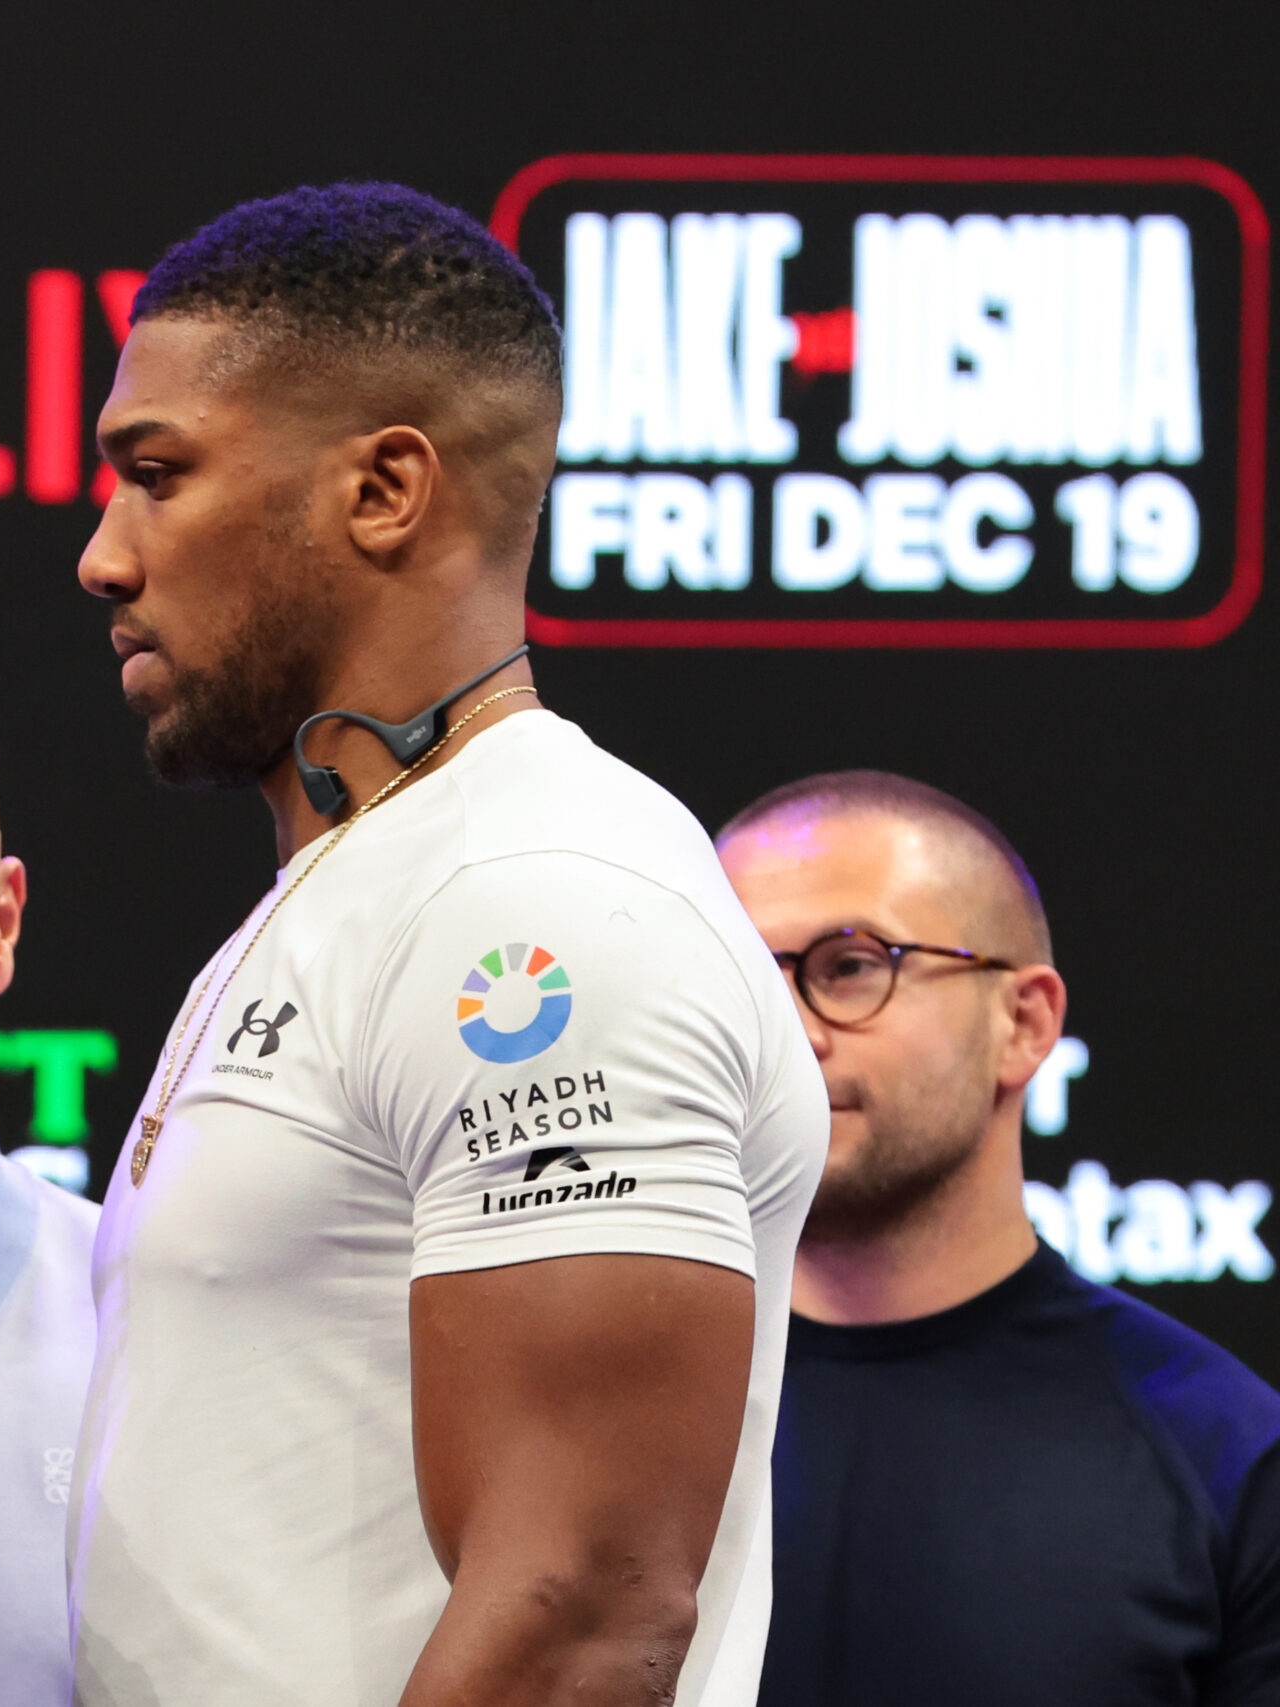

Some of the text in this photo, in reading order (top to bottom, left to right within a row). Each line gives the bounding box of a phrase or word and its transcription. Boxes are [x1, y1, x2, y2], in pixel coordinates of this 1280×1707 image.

[558, 212, 1203, 466] JAKE JOSHUA
[550, 471, 1201, 595] FRI DEC 19
[234, 1065, 274, 1081] ARMOUR
[459, 1070, 606, 1132] RIYADH
[467, 1101, 613, 1162] SEASON
